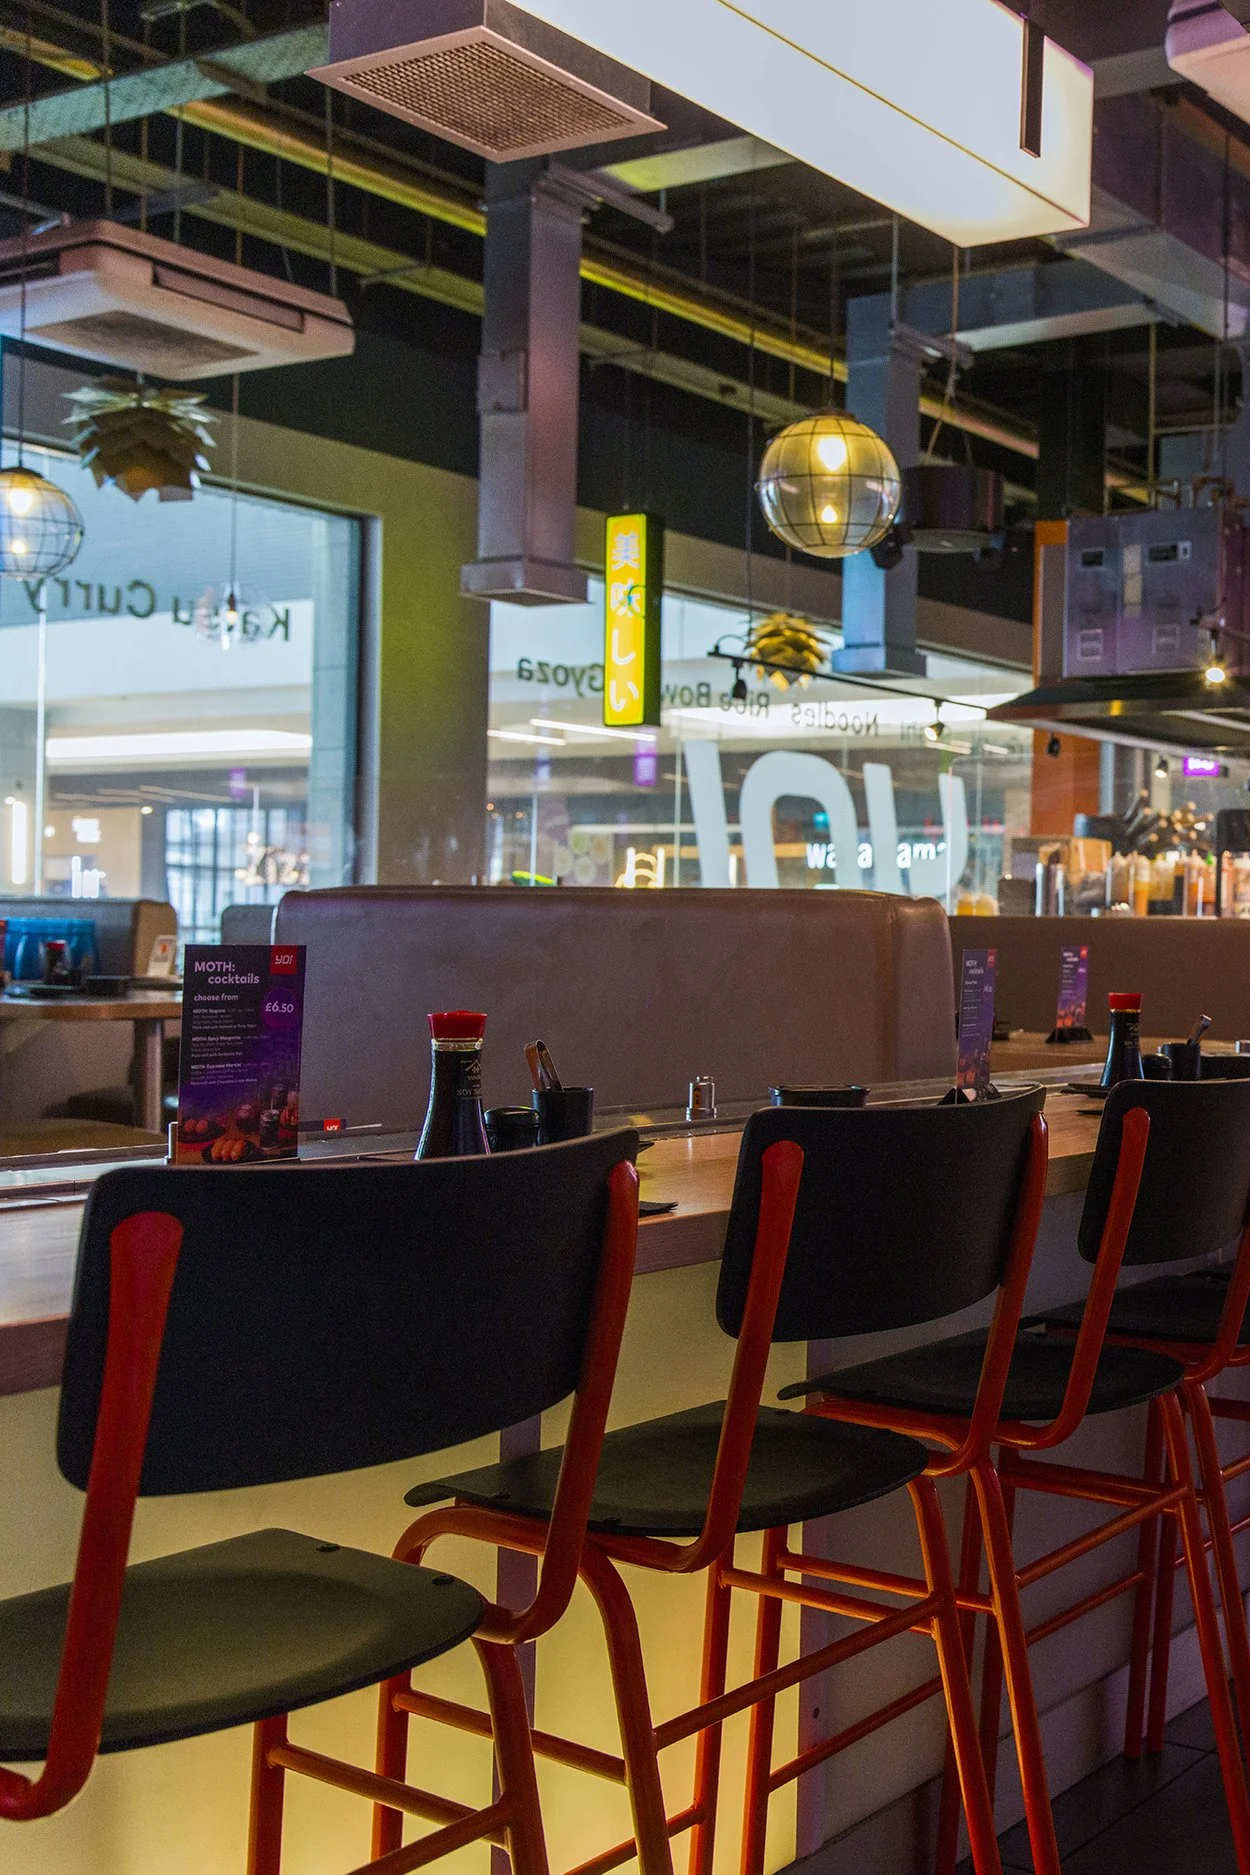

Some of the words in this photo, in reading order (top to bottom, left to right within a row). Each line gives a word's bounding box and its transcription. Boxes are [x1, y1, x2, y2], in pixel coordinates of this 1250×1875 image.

[609, 532, 641, 712] 美味しい
[805, 842, 947, 869] waaam
[194, 961, 236, 972] MOTH:
[208, 973, 260, 984] cocktails
[193, 993, 219, 1002] choose
[221, 992, 239, 1001] from
[265, 1001, 294, 1013] £6.50
